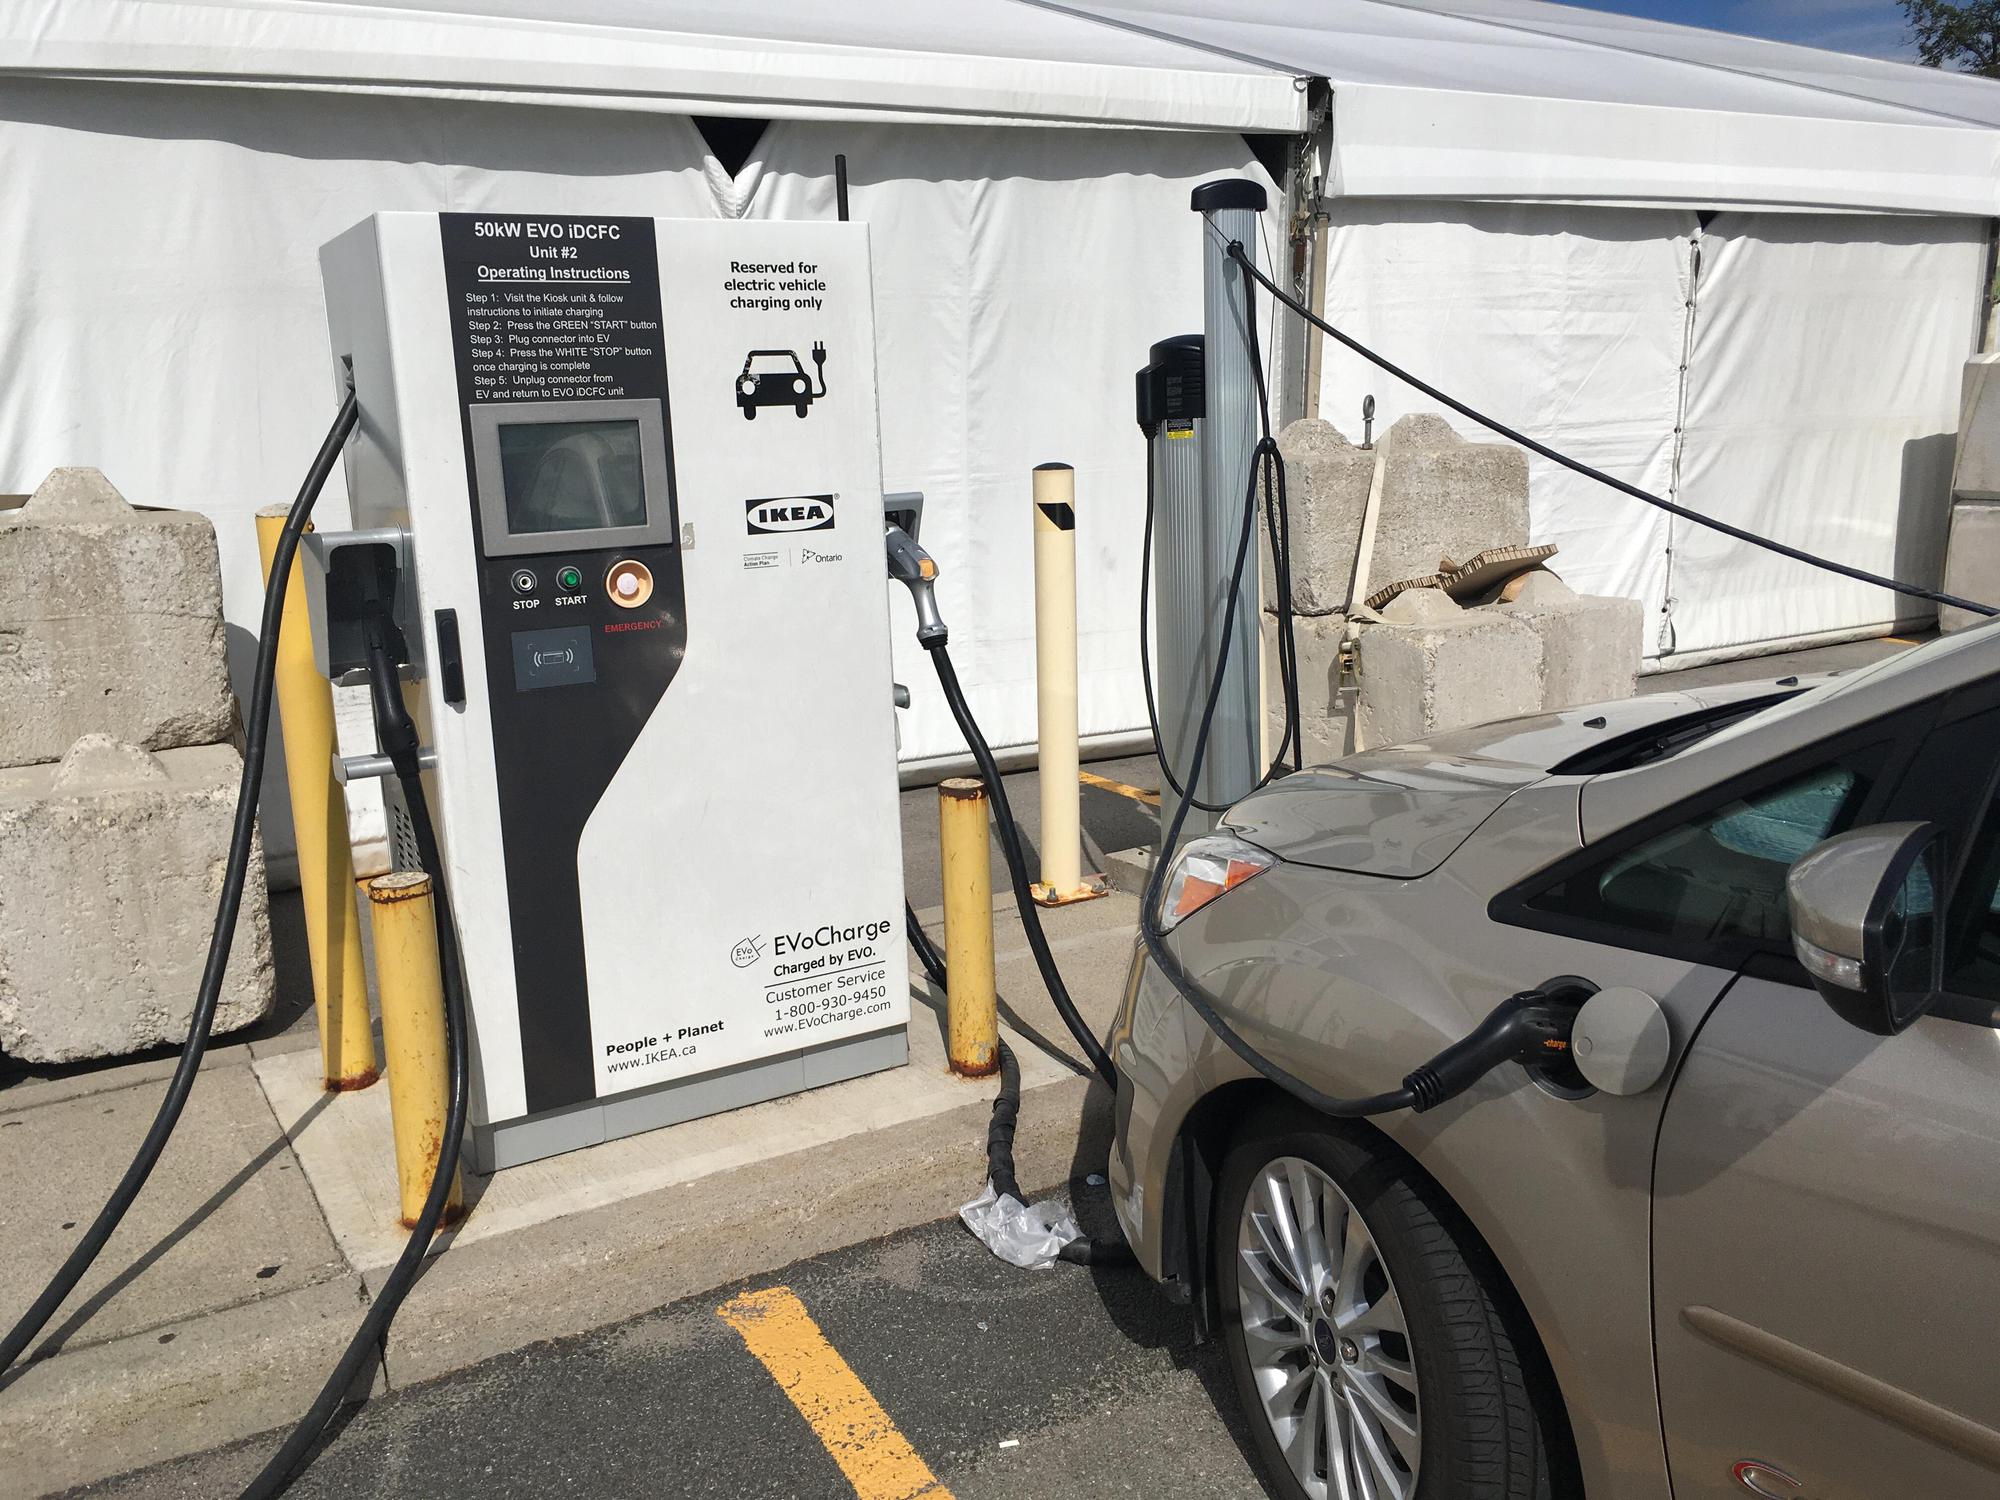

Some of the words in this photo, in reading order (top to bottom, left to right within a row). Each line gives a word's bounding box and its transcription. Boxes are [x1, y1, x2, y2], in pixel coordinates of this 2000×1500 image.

[475, 222, 521, 237] 50kW
[527, 223, 563, 238] EVO
[569, 224, 620, 240] iDCFC
[530, 246, 558, 258] Unit
[561, 247, 577, 259] #2
[478, 266, 546, 280] Operating
[551, 267, 630, 279] Instructions
[730, 261, 794, 274] Reserved
[798, 262, 817, 274] for
[724, 279, 775, 291] electric
[779, 279, 826, 291] vehicle
[466, 293, 487, 304] Step
[491, 294, 499, 302] 1:
[504, 293, 523, 302] Visit
[526, 294, 540, 302] the
[544, 294, 568, 302] Kiosk
[571, 294, 587, 302] unit
[590, 294, 596, 302] &
[598, 294, 623, 302] follow
[730, 297, 790, 311] charging
[794, 297, 822, 310] only
[467, 308, 520, 316] instructions
[534, 308, 562, 316] initiate
[566, 308, 603, 318] charging
[469, 321, 490, 330] Step
[494, 321, 502, 330] 2:
[508, 321, 533, 329] Press
[536, 321, 550, 329] the
[553, 320, 588, 329] GREEN
[630, 320, 657, 328] button
[471, 335, 492, 345] Step
[495, 335, 503, 343] 3:
[509, 334, 529, 345] Plug
[532, 334, 576, 343] connector
[579, 334, 594, 342] into
[597, 334, 610, 342] EV
[472, 349, 493, 359] Step
[496, 349, 504, 357] 4:
[510, 348, 536, 357] Press
[539, 348, 553, 356] the
[555, 348, 587, 356] WHITE
[625, 347, 651, 355] button
[499, 362, 537, 372] charging
[540, 362, 548, 370] is
[550, 361, 590, 371] complete
[475, 376, 496, 386] Step
[499, 376, 507, 384] 5:
[513, 376, 545, 386] Unplug
[548, 375, 591, 384] connector
[594, 374, 613, 383] from
[476, 390, 489, 398] EV
[492, 389, 510, 398] and
[513, 389, 539, 398] return
[542, 388, 550, 397] to
[553, 388, 573, 396] EVO
[576, 387, 606, 396] iDCFC
[608, 387, 624, 395] unit
[758, 505, 825, 523] IKEA
[816, 554, 842, 562] Ontario
[513, 600, 540, 609] STOP
[555, 596, 587, 606] START
[605, 620, 662, 632] EMERGENCY
[774, 920, 890, 955] EVoCharge
[774, 957, 824, 977] Charged
[829, 953, 844, 966] by
[848, 946, 876, 962] EVO.
[765, 980, 832, 1004] Customer
[837, 968, 885, 989] Service
[775, 986, 886, 1021] 1-800-930-9450
[764, 1000, 891, 1038] www.EVoCharge.com
[606, 1035, 657, 1056] People
[663, 1032, 672, 1043] +
[678, 1020, 724, 1040] Planet
[608, 1044, 696, 1074] www.IKEA.ca
